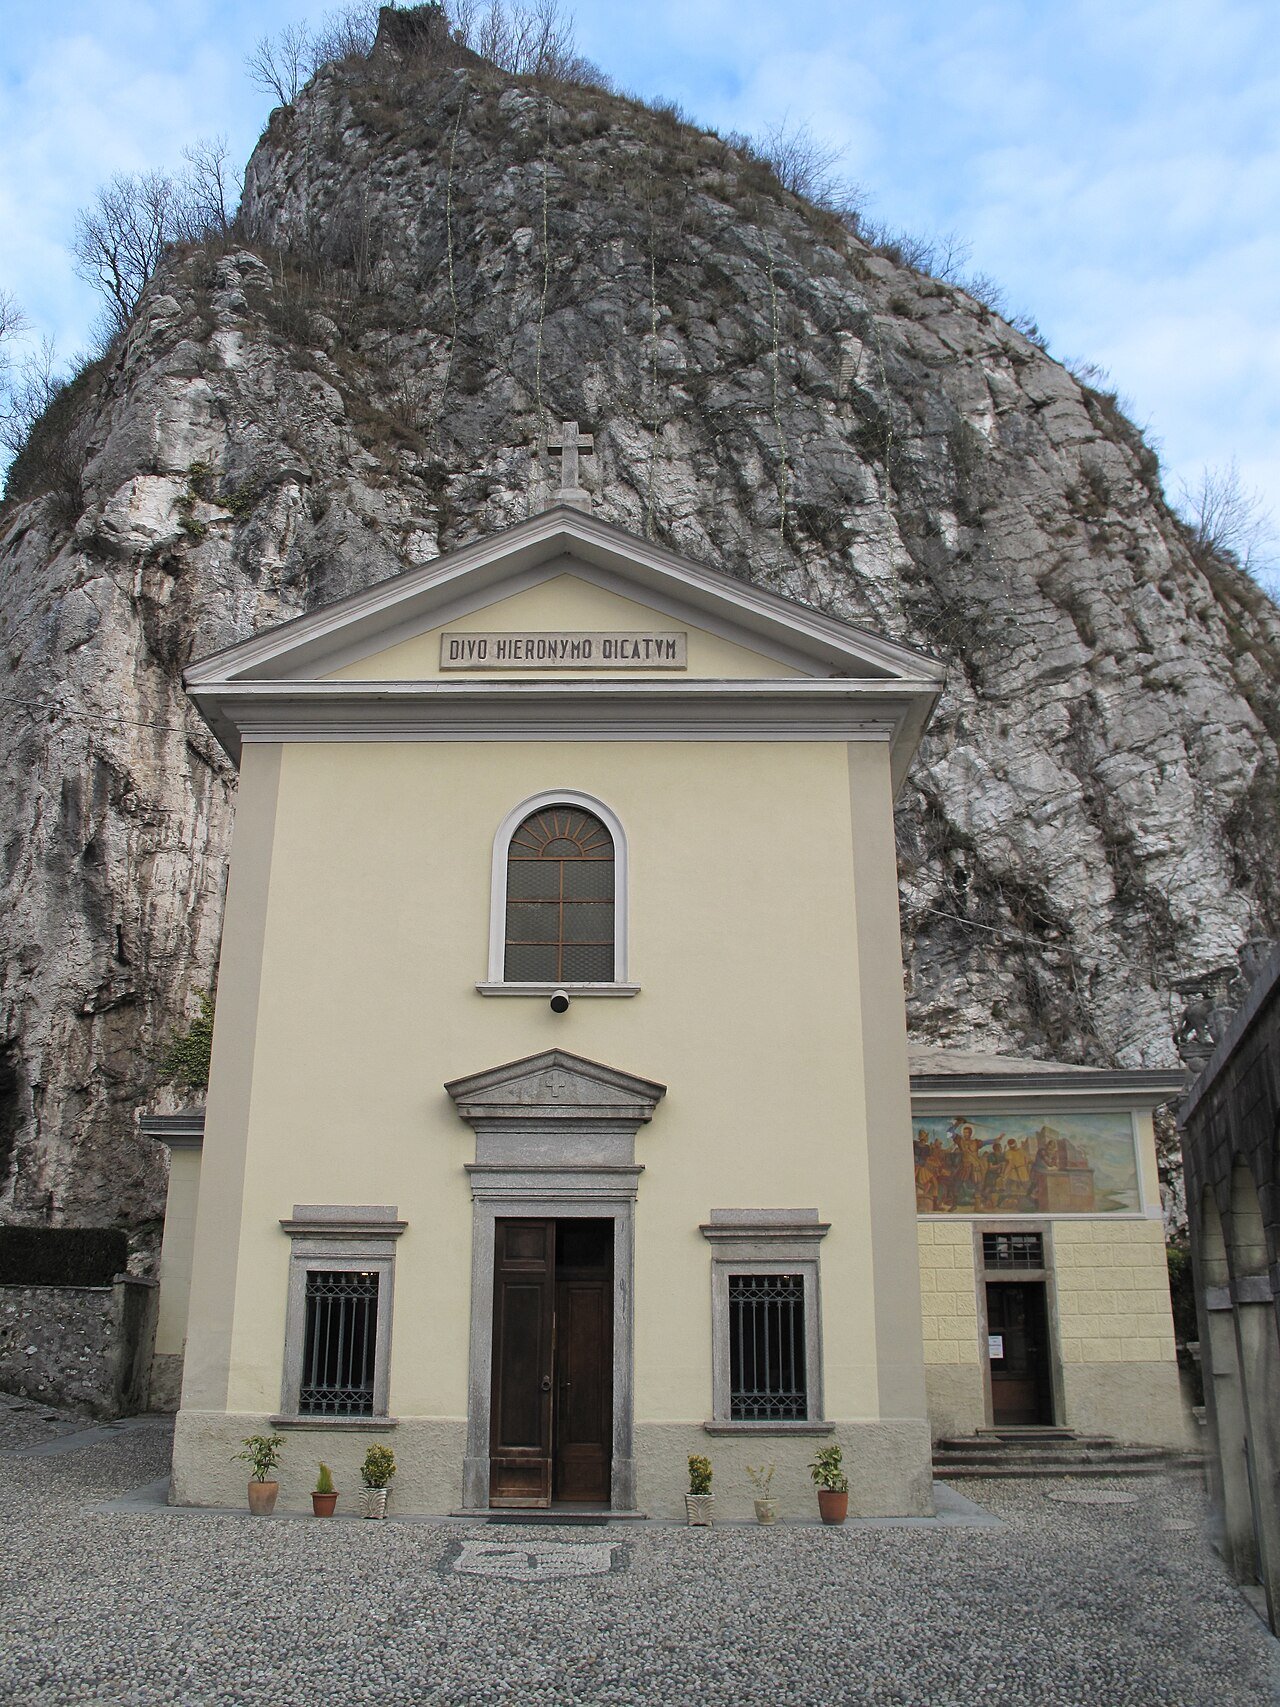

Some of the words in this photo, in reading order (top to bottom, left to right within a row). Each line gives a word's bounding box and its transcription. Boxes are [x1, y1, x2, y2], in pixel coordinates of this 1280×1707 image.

[450, 640, 488, 660] DIVO
[497, 639, 592, 660] HIERONYMO
[603, 639, 676, 660] DICATVM
